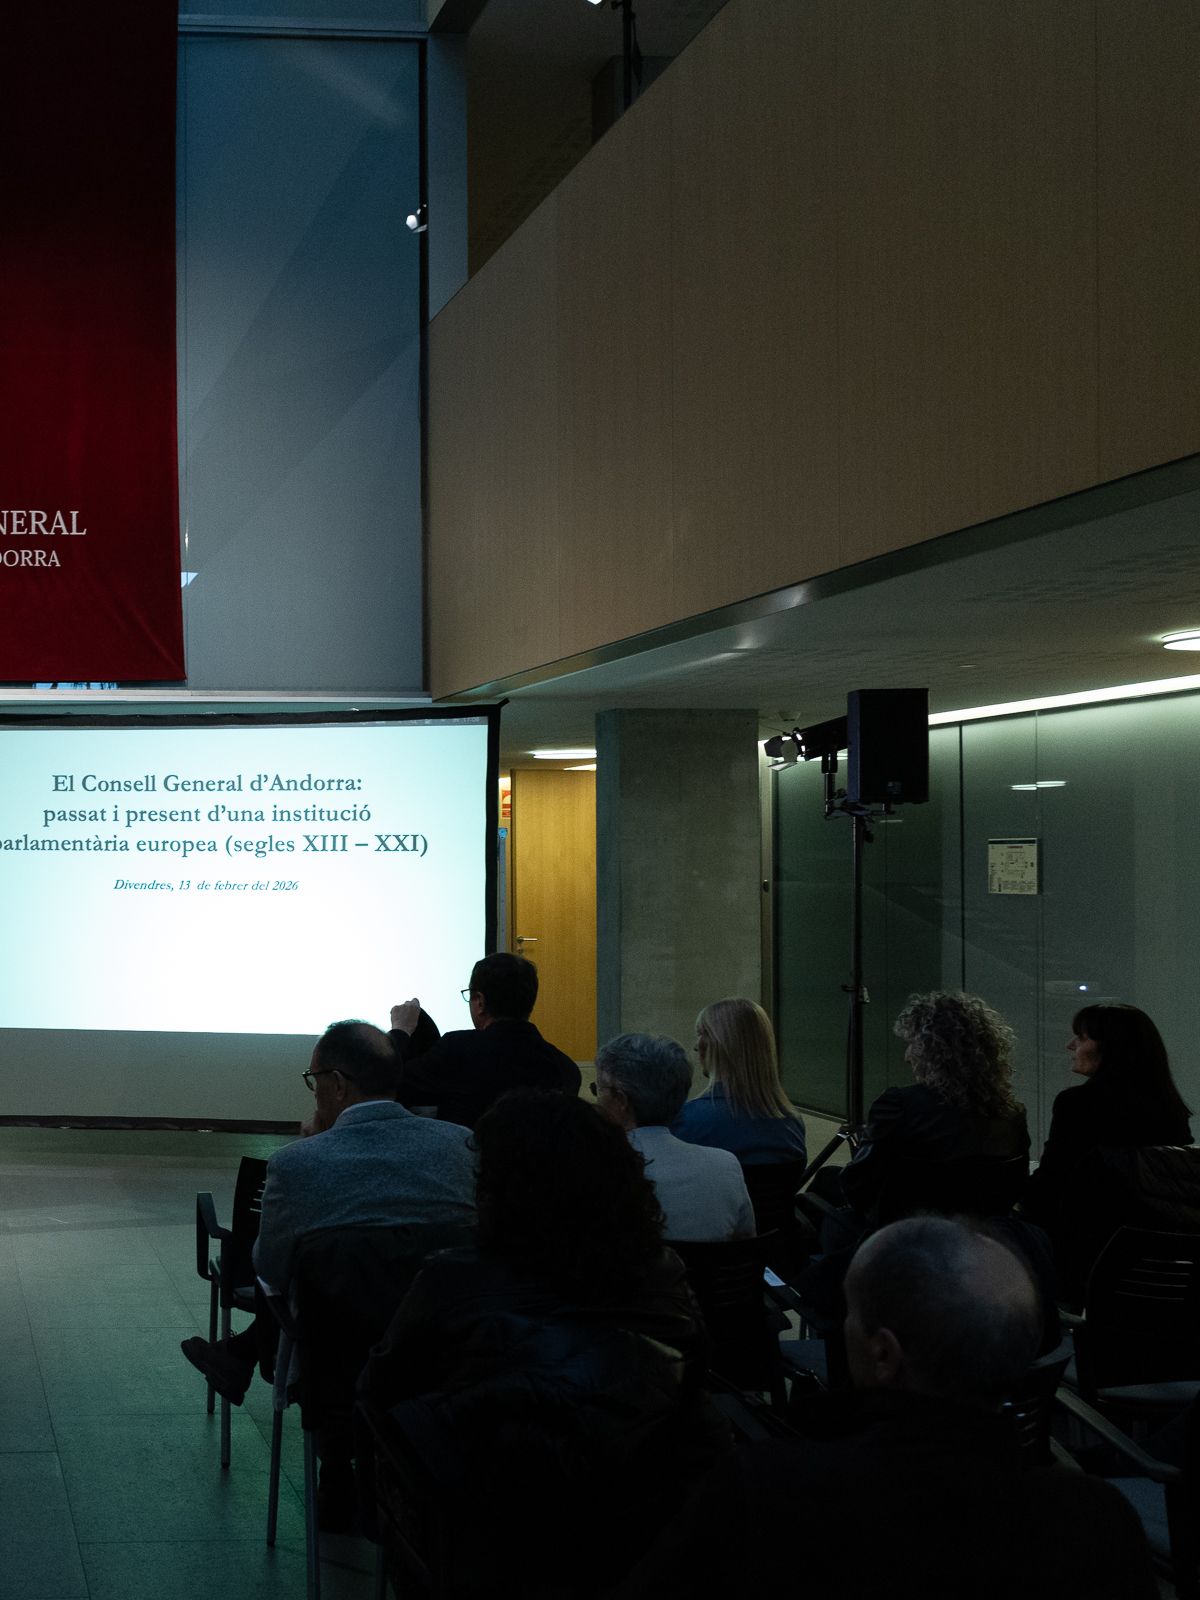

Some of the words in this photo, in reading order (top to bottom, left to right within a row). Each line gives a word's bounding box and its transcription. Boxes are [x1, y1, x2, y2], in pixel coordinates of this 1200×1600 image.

[52, 775, 75, 791] El
[82, 775, 157, 792] Consell
[163, 774, 243, 792] General
[250, 774, 361, 791] d’Andorra:
[43, 809, 106, 827] passat
[113, 805, 119, 821] i
[125, 809, 200, 828] present
[208, 805, 265, 821] d’una
[272, 804, 371, 821] institució
[136, 840, 218, 858] europea
[226, 835, 295, 858] (segles
[303, 835, 348, 852] XIII
[374, 834, 428, 857] XXI)
[113, 880, 174, 892] Divendres,
[179, 880, 191, 890] 13
[197, 880, 211, 890] de
[214, 880, 249, 890] febrer
[252, 881, 270, 890] del
[272, 881, 299, 890] 2026
